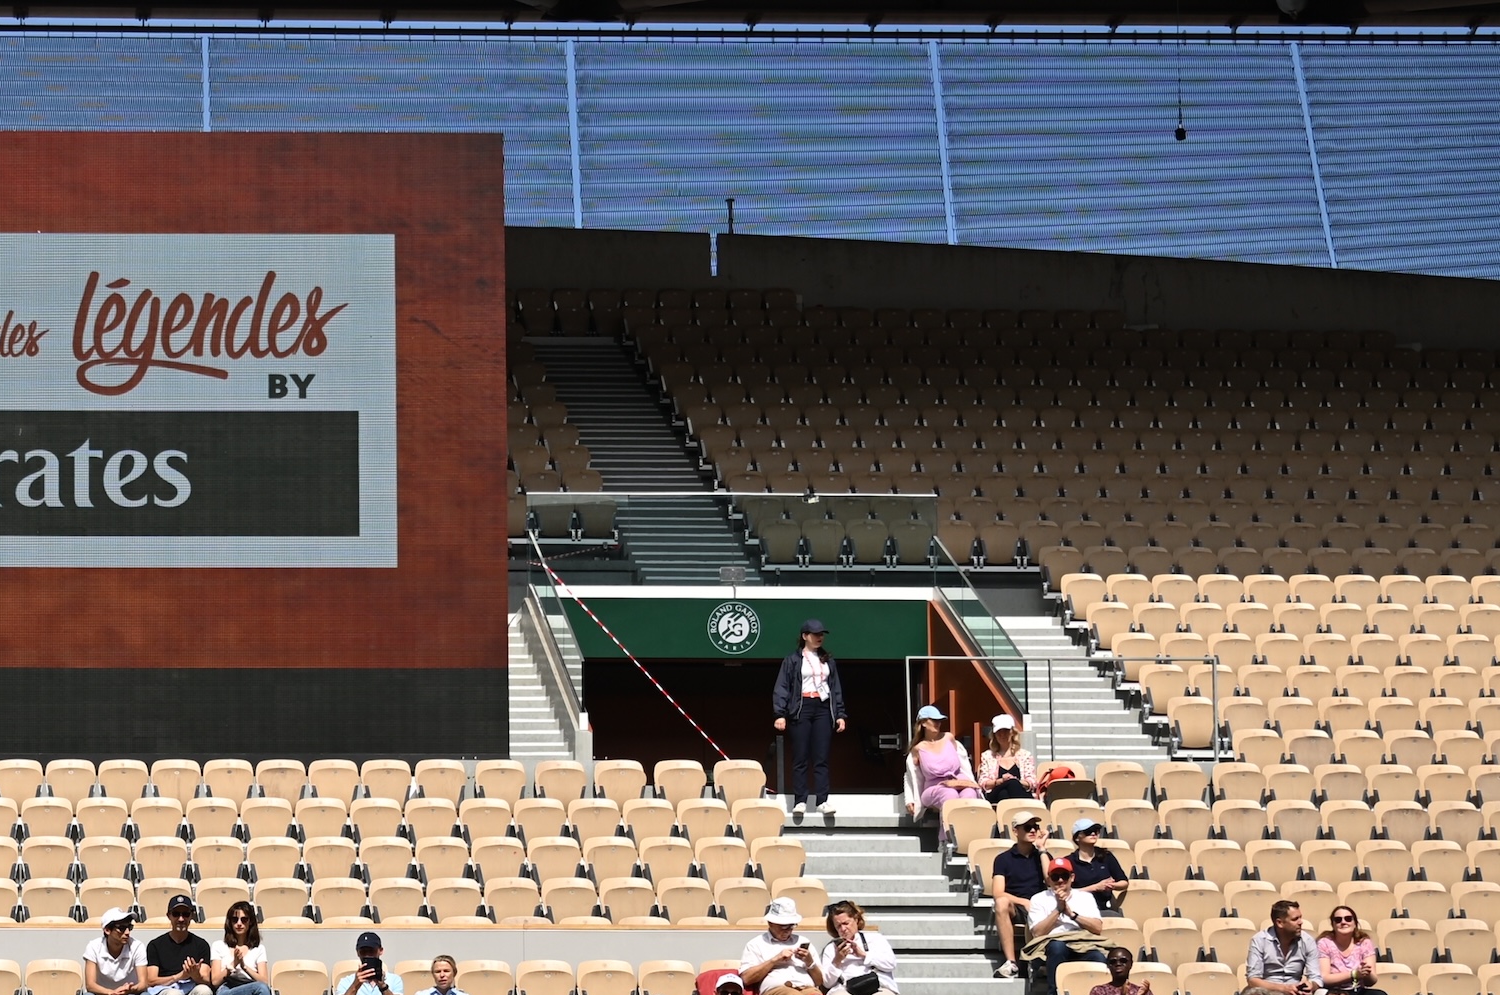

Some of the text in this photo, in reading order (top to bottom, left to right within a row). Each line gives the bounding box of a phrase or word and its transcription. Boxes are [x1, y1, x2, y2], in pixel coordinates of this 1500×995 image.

[268, 374, 316, 400] BY
[710, 604, 758, 634] ROLAND GARROS
